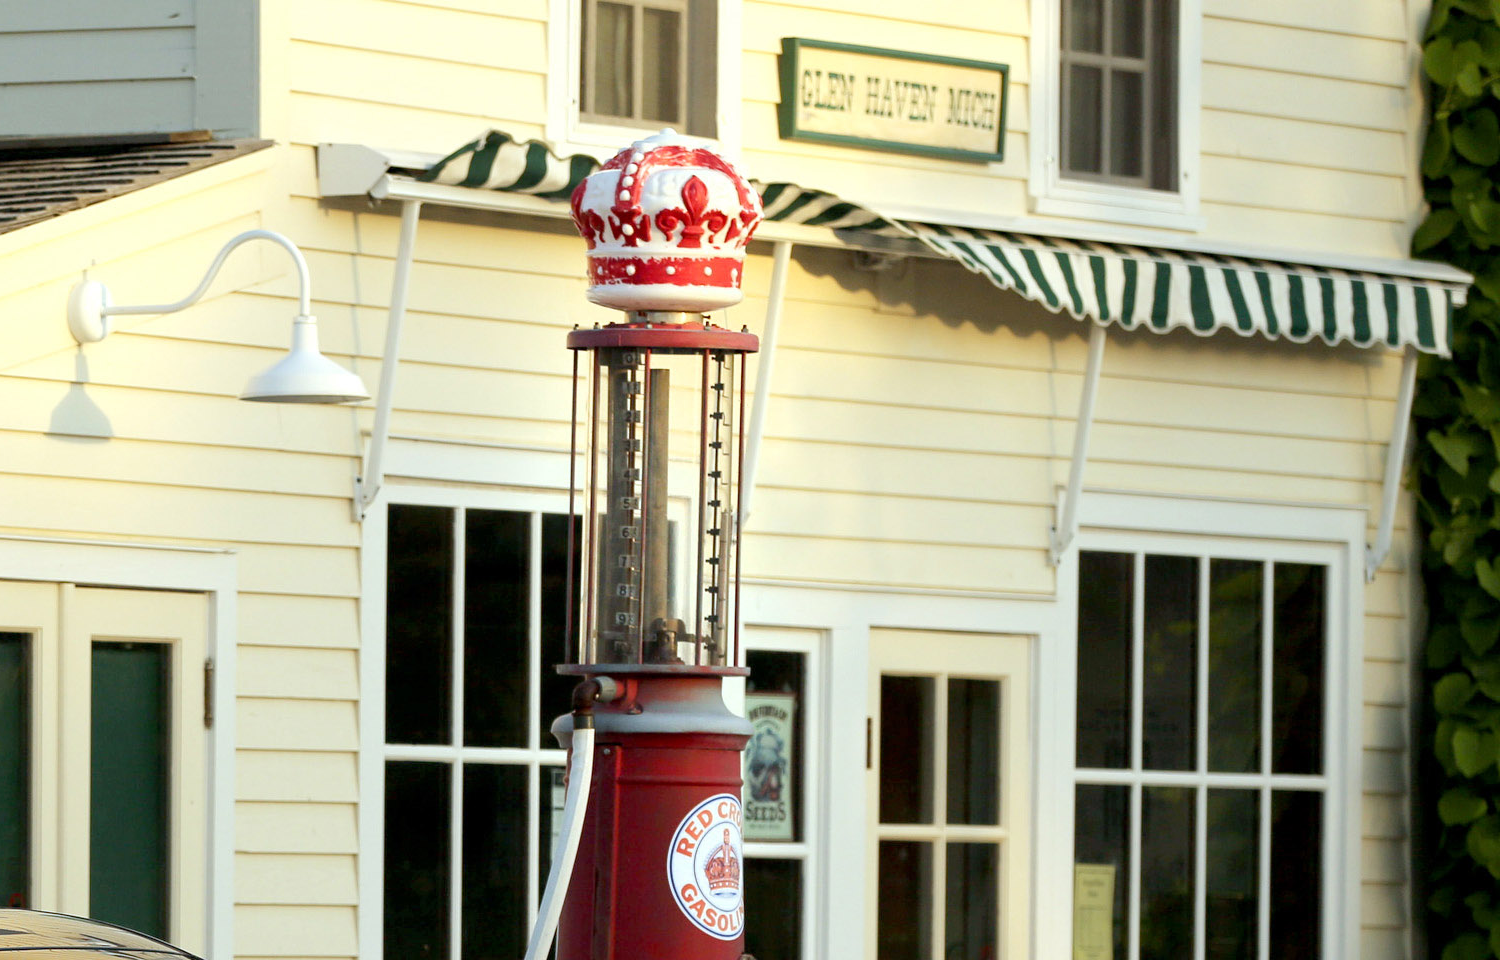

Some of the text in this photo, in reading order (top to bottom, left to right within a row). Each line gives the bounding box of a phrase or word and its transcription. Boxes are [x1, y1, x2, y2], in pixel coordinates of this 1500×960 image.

[802, 69, 997, 131] GLEN HAVEN MICH
[676, 801, 743, 858] RED CRO
